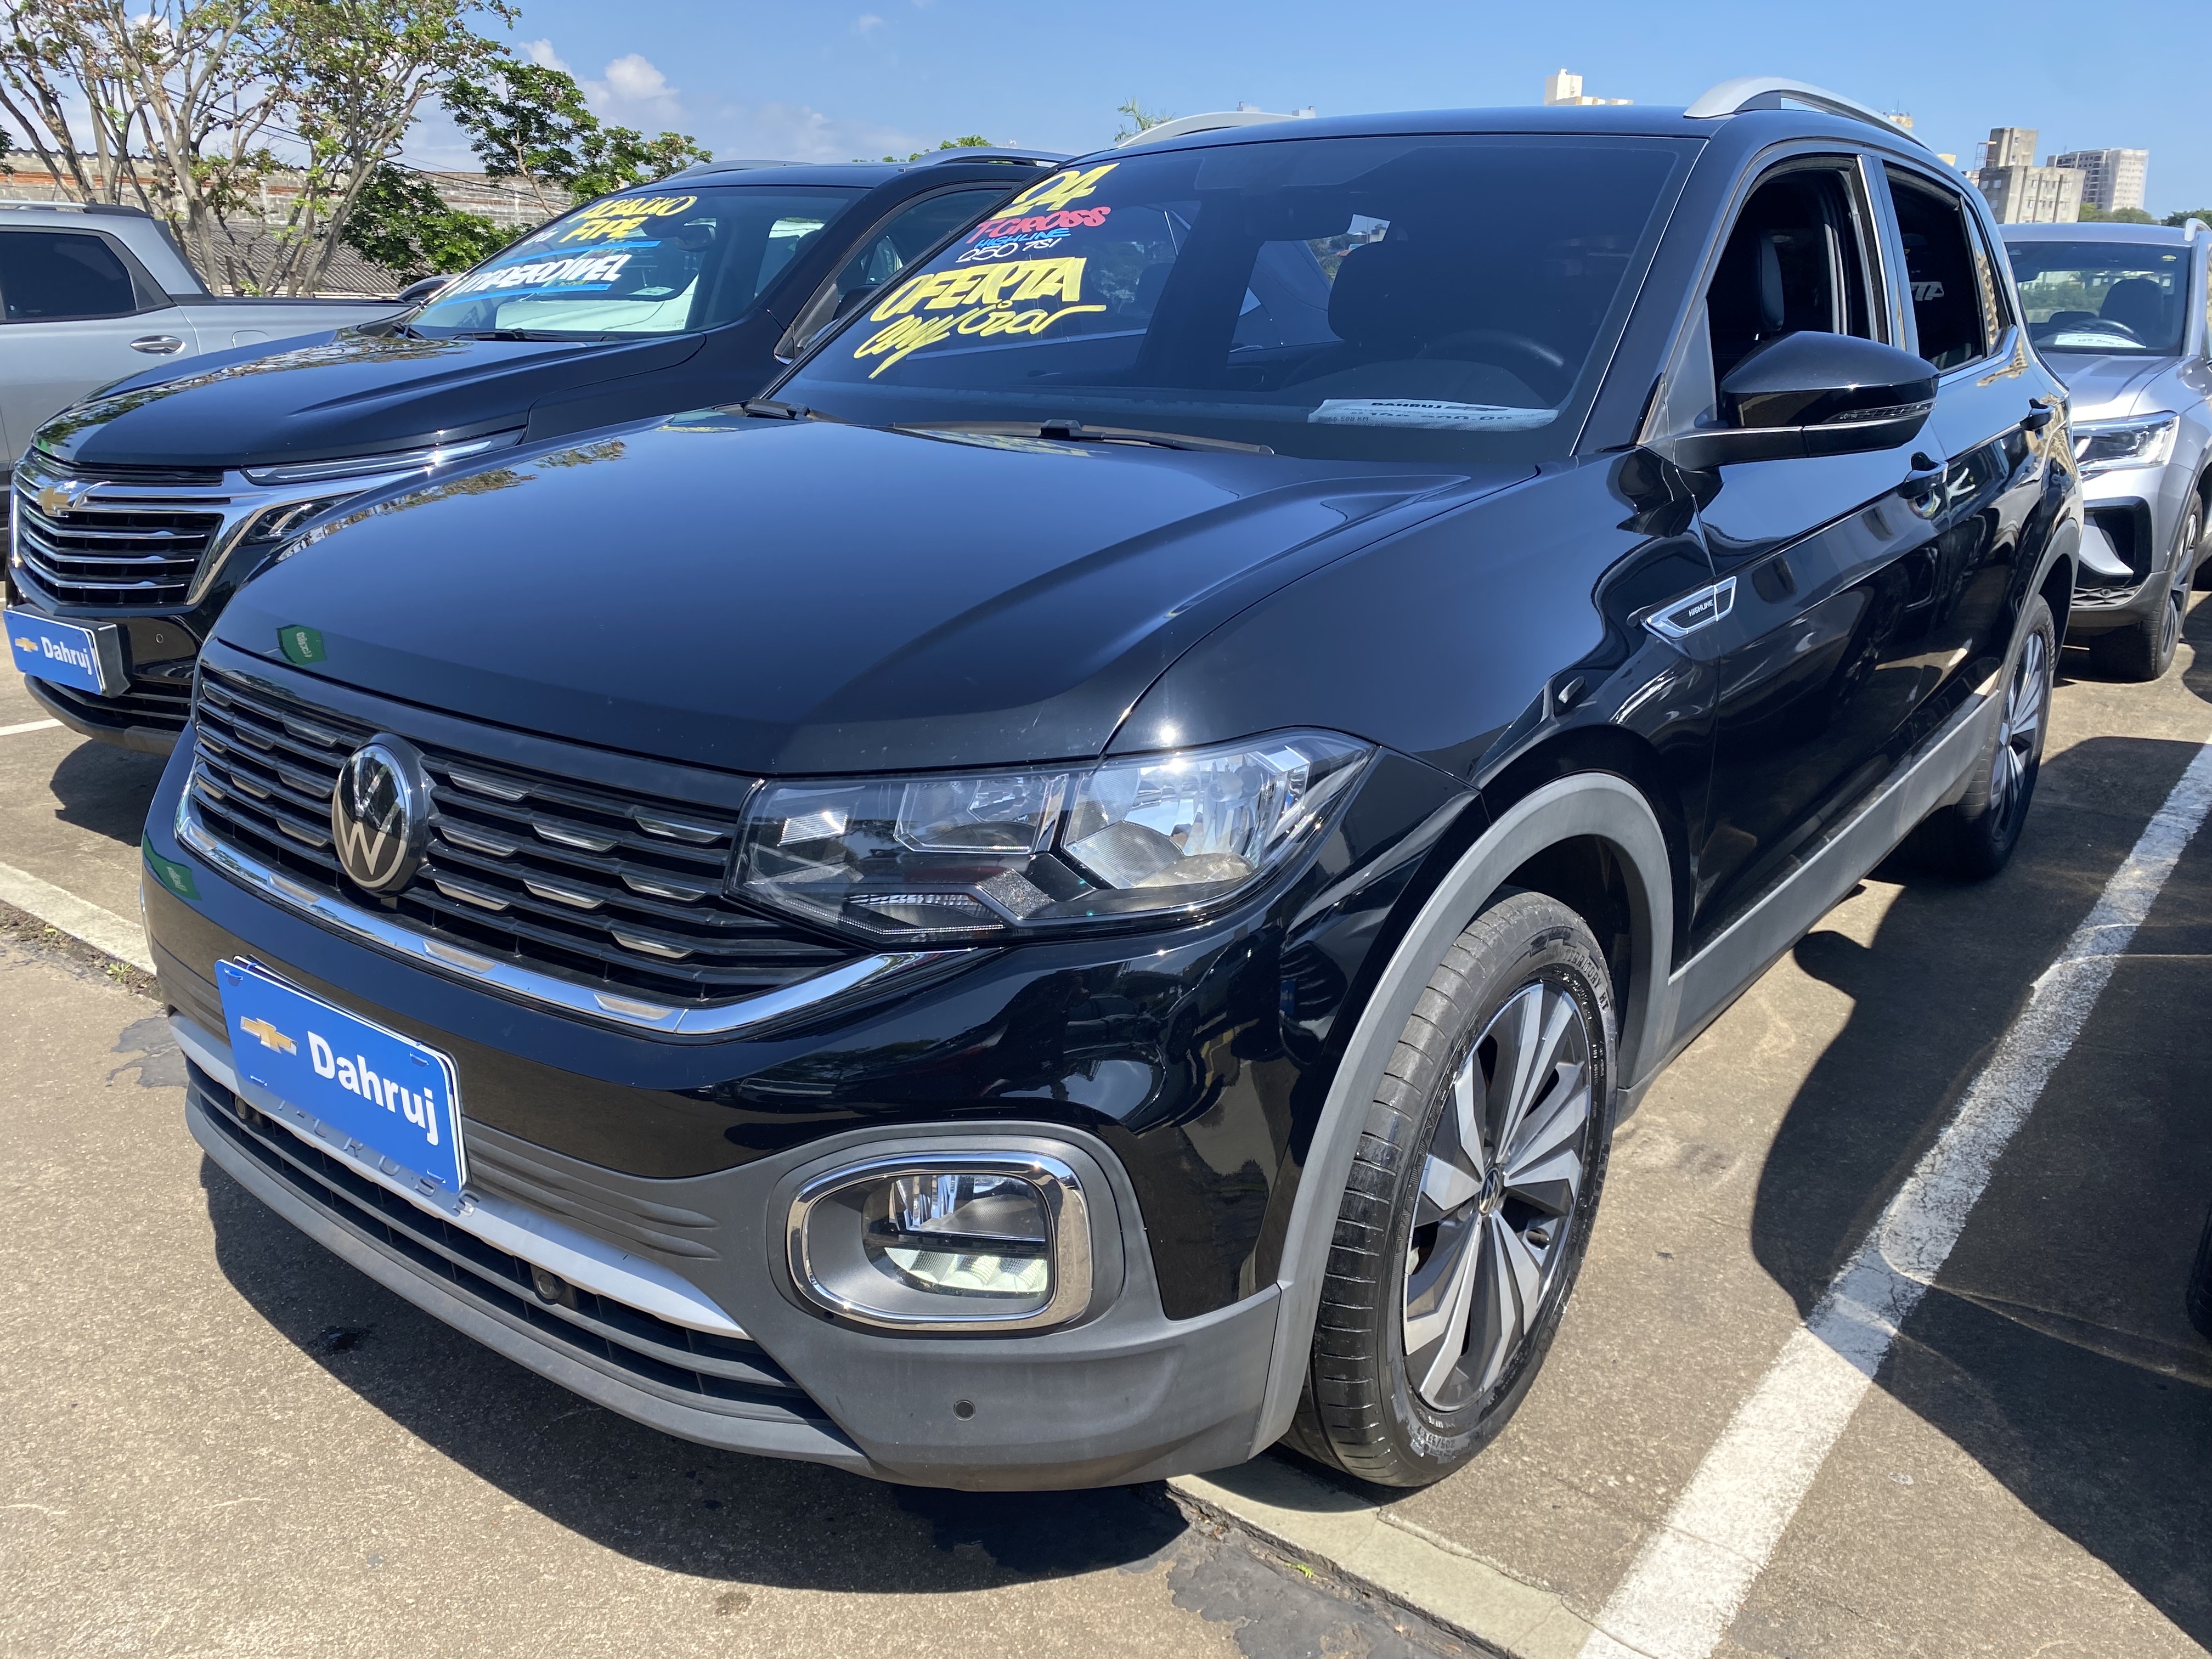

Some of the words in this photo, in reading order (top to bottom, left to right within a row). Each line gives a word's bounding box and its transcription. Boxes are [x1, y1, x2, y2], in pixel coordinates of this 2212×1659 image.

[990, 162, 1120, 220] 24
[567, 195, 698, 223] ABAIXO
[966, 206, 1111, 244] T-CROSS
[557, 216, 649, 243] FIPE
[974, 228, 1071, 249] HIGHLINE
[955, 242, 1018, 263] 250
[1023, 238, 1062, 251] TSI
[870, 256, 1087, 323] OFERTA
[1688, 599, 1714, 617] HIGHLINE
[40, 636, 93, 676] Dahruj
[307, 1030, 439, 1147] Dahruj
